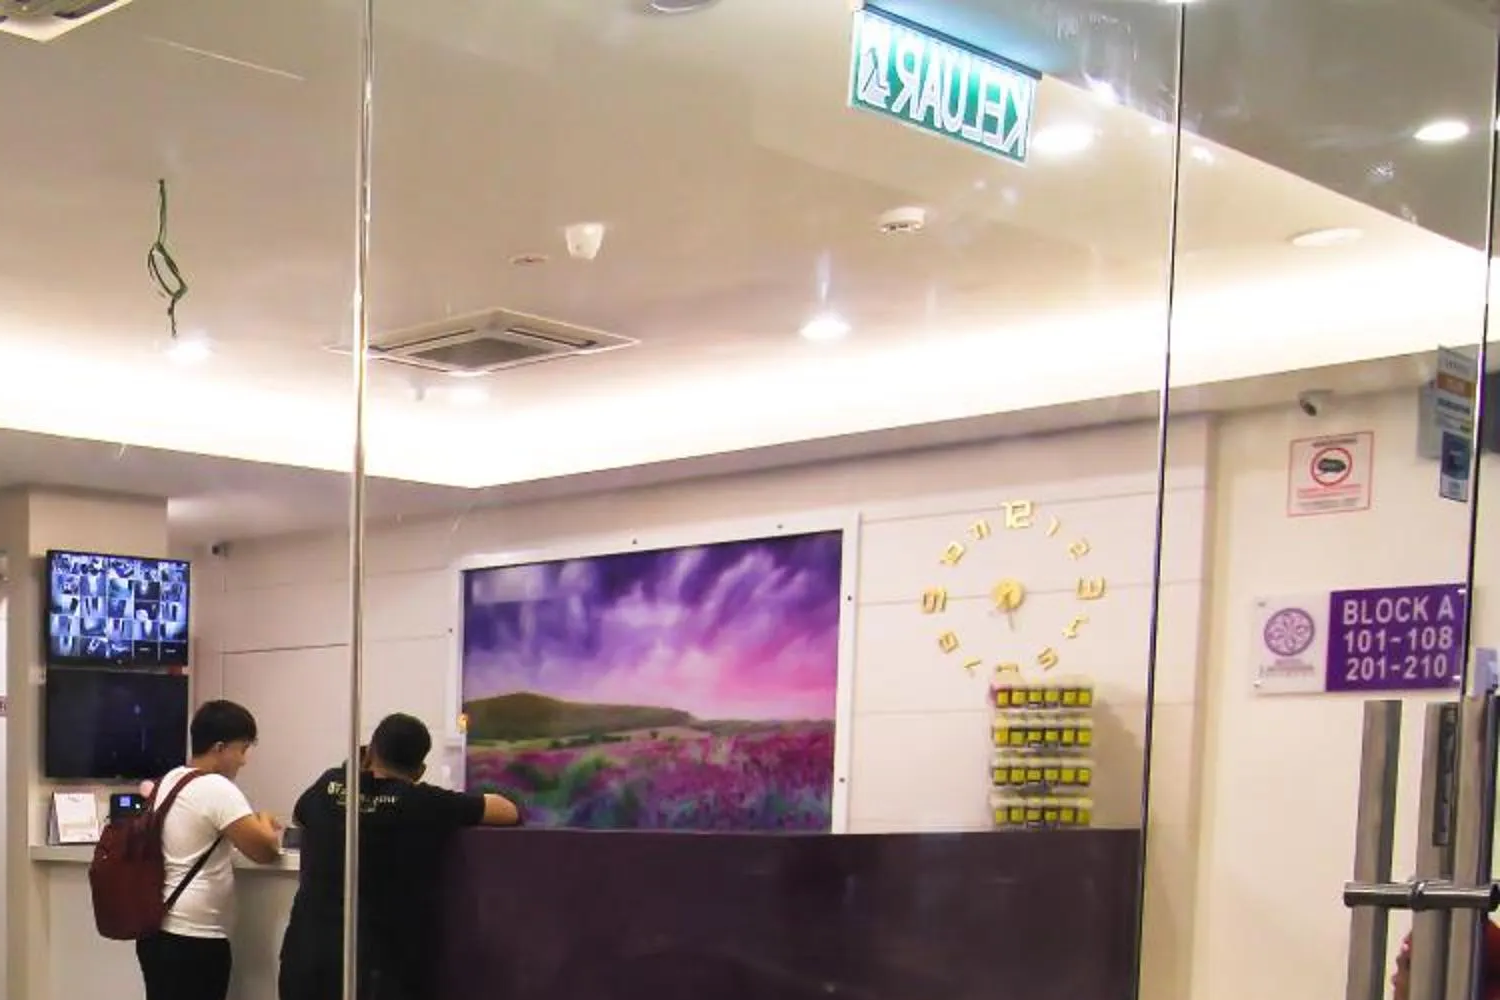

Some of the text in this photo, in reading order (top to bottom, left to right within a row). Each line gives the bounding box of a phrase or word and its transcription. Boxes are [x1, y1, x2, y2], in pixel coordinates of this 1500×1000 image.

[1000, 499, 1033, 529] 12
[1343, 595, 1456, 626] BLOCK A
[1343, 625, 1454, 654] 101-108
[1345, 654, 1448, 682] 201-210
